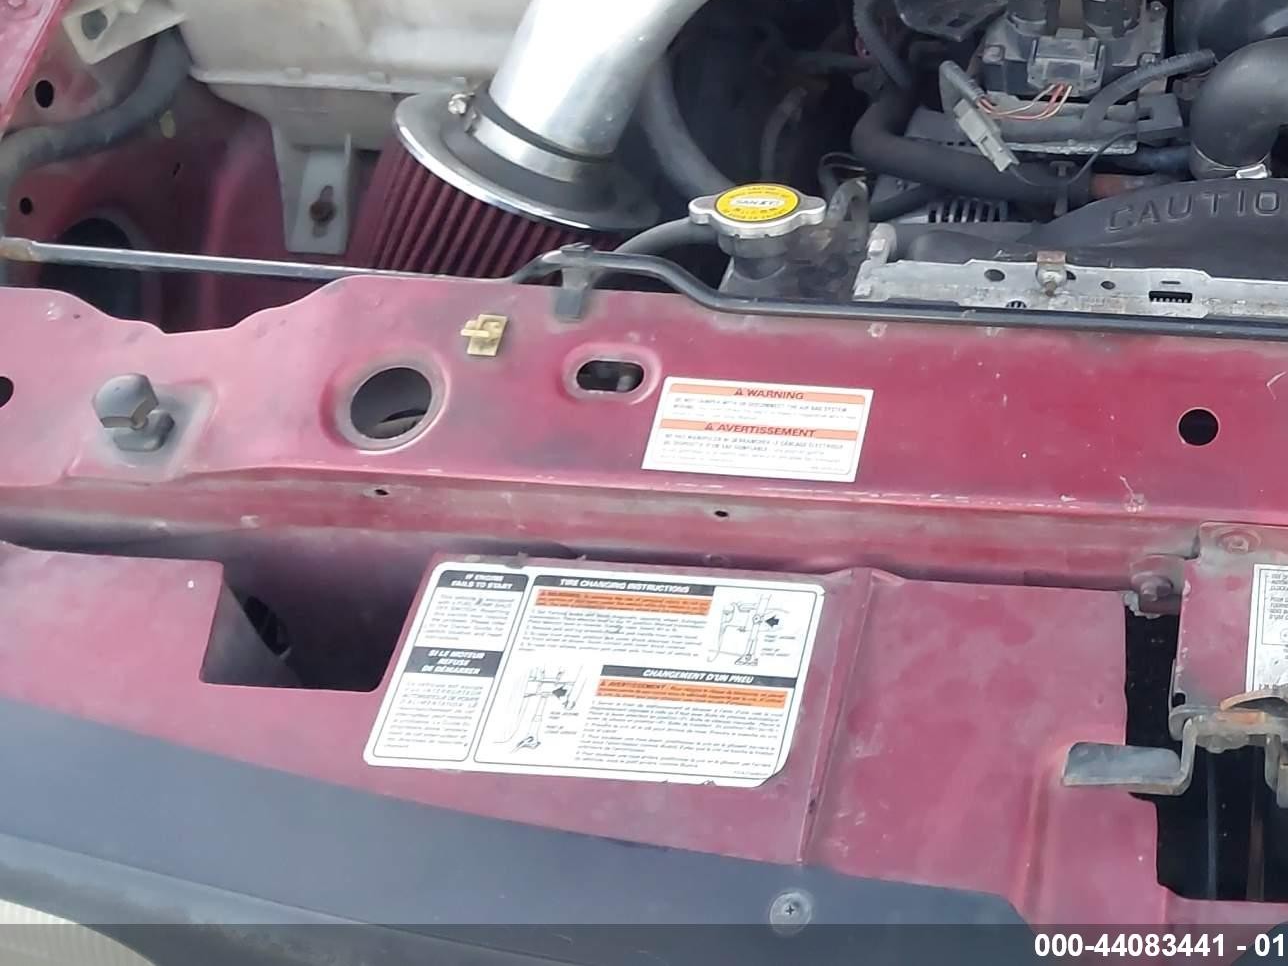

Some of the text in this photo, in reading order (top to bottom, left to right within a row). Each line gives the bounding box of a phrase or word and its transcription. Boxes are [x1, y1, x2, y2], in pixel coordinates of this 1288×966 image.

[747, 390, 804, 400] WARNING
[717, 424, 816, 438] AVERTISSEMENT
[560, 578, 690, 594] TIRE CHANGING INSTRUCTIONS
[449, 651, 485, 659] MOTEUR
[643, 669, 755, 684] CHANGEMENT D'UN PNEU
